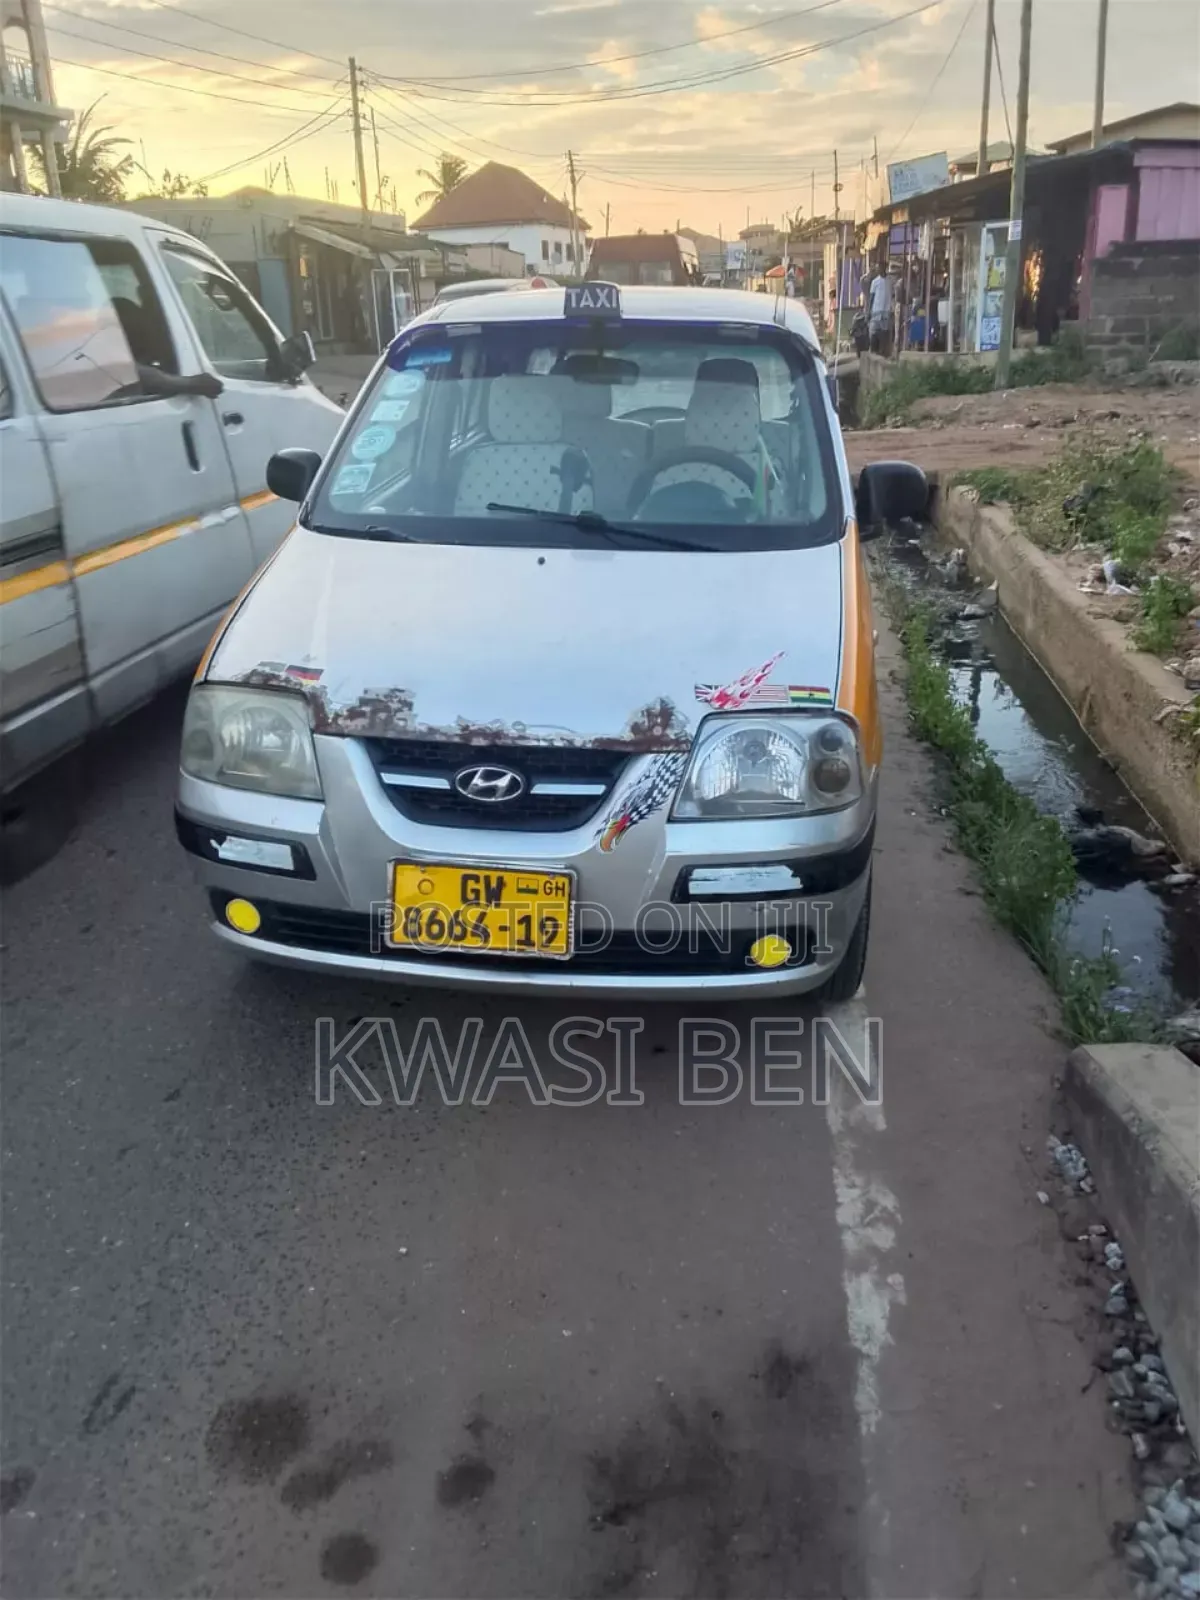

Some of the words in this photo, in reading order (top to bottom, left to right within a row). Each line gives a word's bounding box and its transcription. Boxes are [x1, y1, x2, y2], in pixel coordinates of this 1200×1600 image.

[567, 287, 618, 309] TAXI
[461, 873, 504, 908] GW
[543, 881, 566, 897] GH
